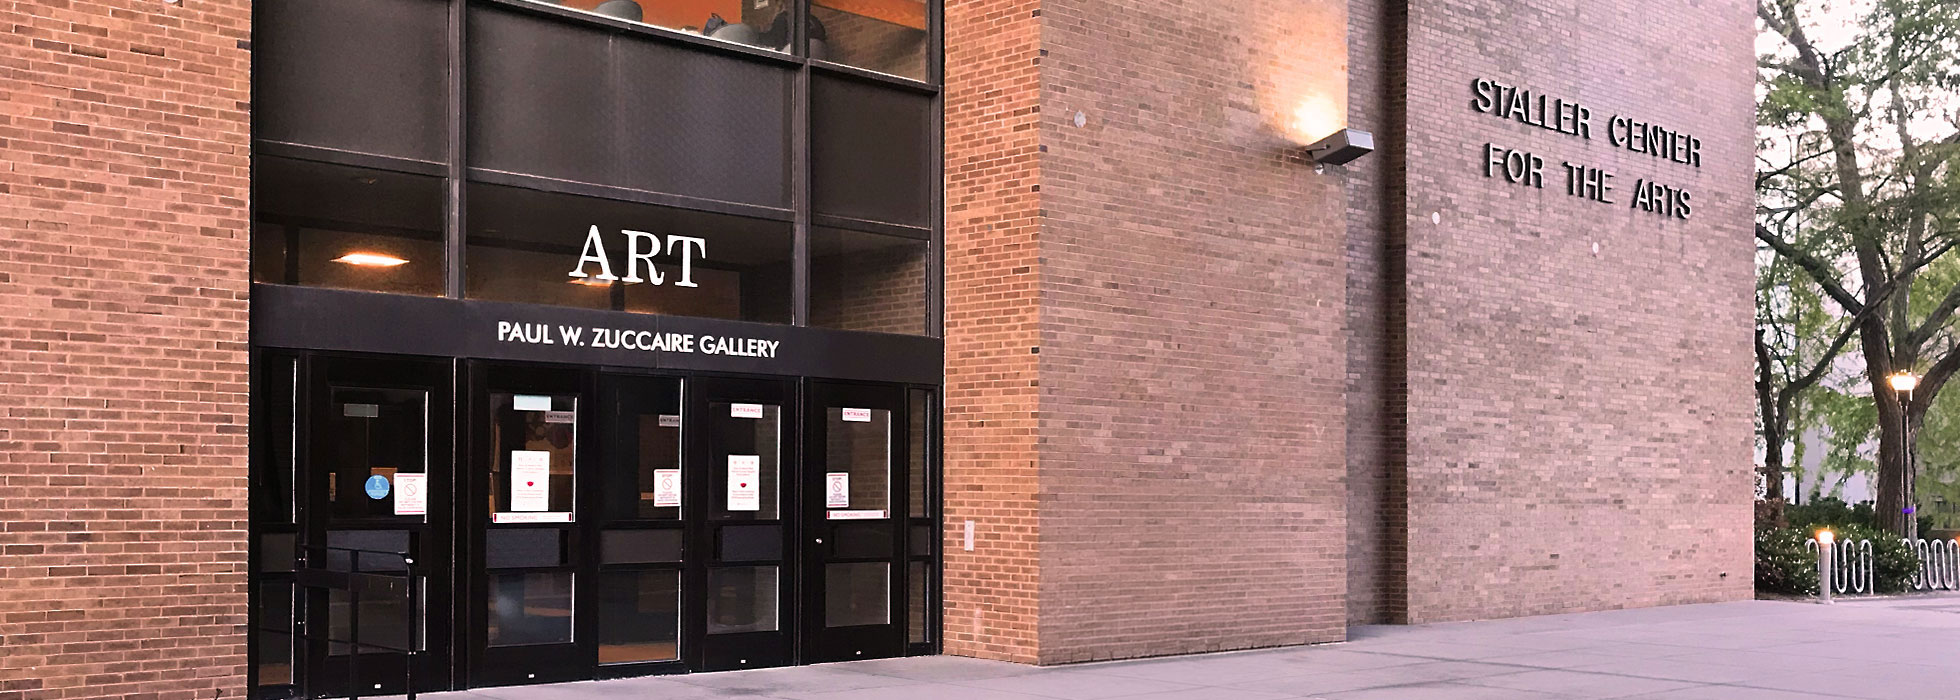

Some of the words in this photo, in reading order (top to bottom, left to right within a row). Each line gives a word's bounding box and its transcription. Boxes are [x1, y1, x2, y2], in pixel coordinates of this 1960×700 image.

[1472, 77, 1592, 139] STALLER
[1608, 114, 1702, 167] CENTER
[1485, 142, 1544, 188] FOR
[1562, 161, 1614, 204] THE
[1632, 178, 1692, 219] ARTS
[568, 224, 706, 288] ART
[498, 321, 554, 345] PAUL
[559, 325, 585, 347] W.
[591, 328, 694, 353] ZUCCAIRE
[699, 335, 780, 358] GALLERY
